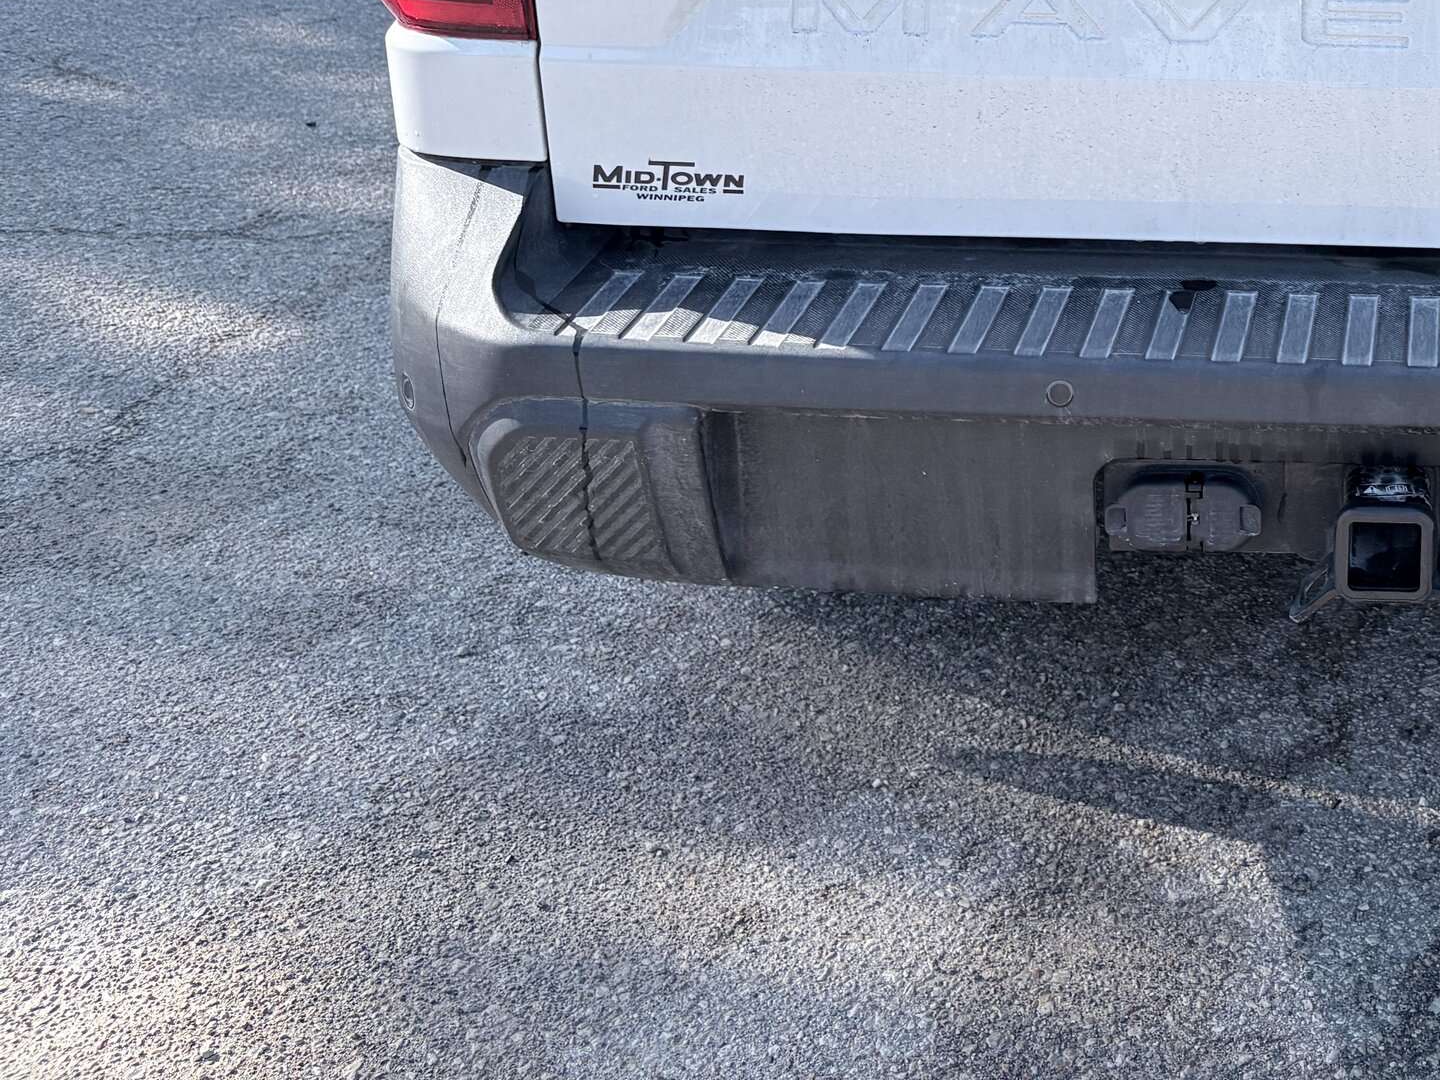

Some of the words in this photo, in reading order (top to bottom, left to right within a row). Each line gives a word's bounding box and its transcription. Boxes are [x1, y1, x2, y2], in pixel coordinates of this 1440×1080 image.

[622, 184, 658, 192] FORD
[674, 186, 717, 194] SALES
[636, 192, 705, 202] WINNIPEG
